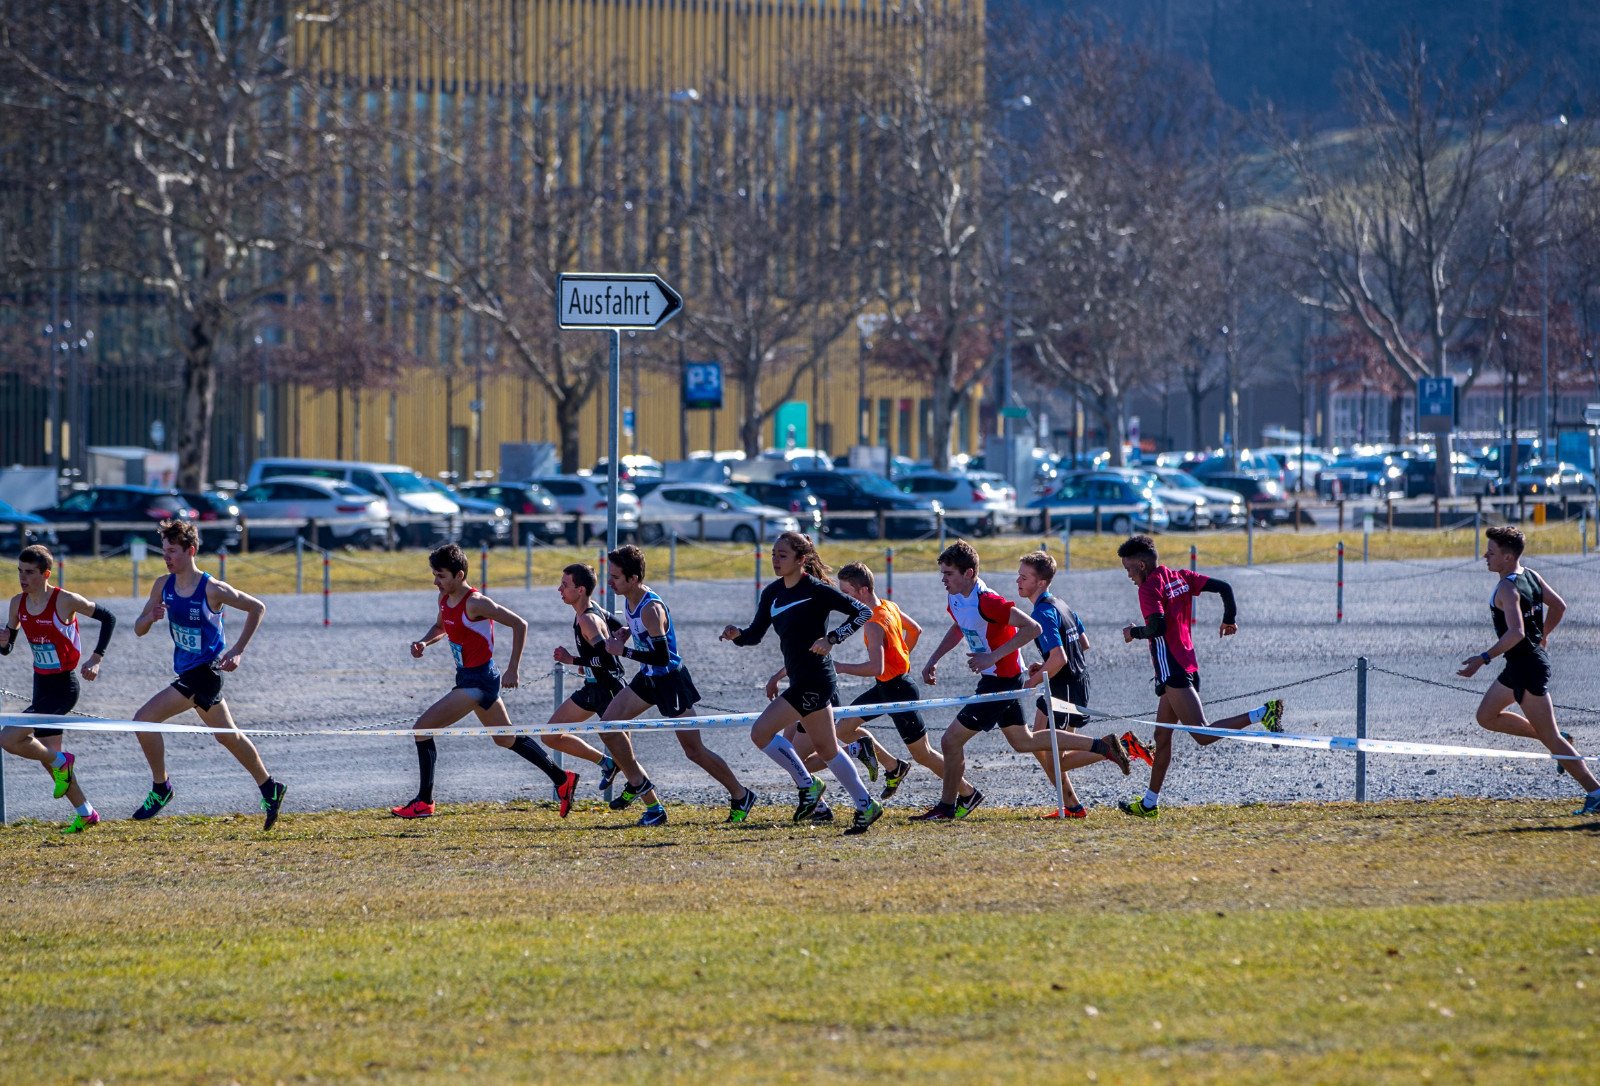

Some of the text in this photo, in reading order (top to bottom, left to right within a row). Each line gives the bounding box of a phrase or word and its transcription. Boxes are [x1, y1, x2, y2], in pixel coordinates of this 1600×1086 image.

[568, 285, 650, 315] Ausfahrt
[687, 365, 718, 389] P3
[1424, 380, 1446, 398] P1
